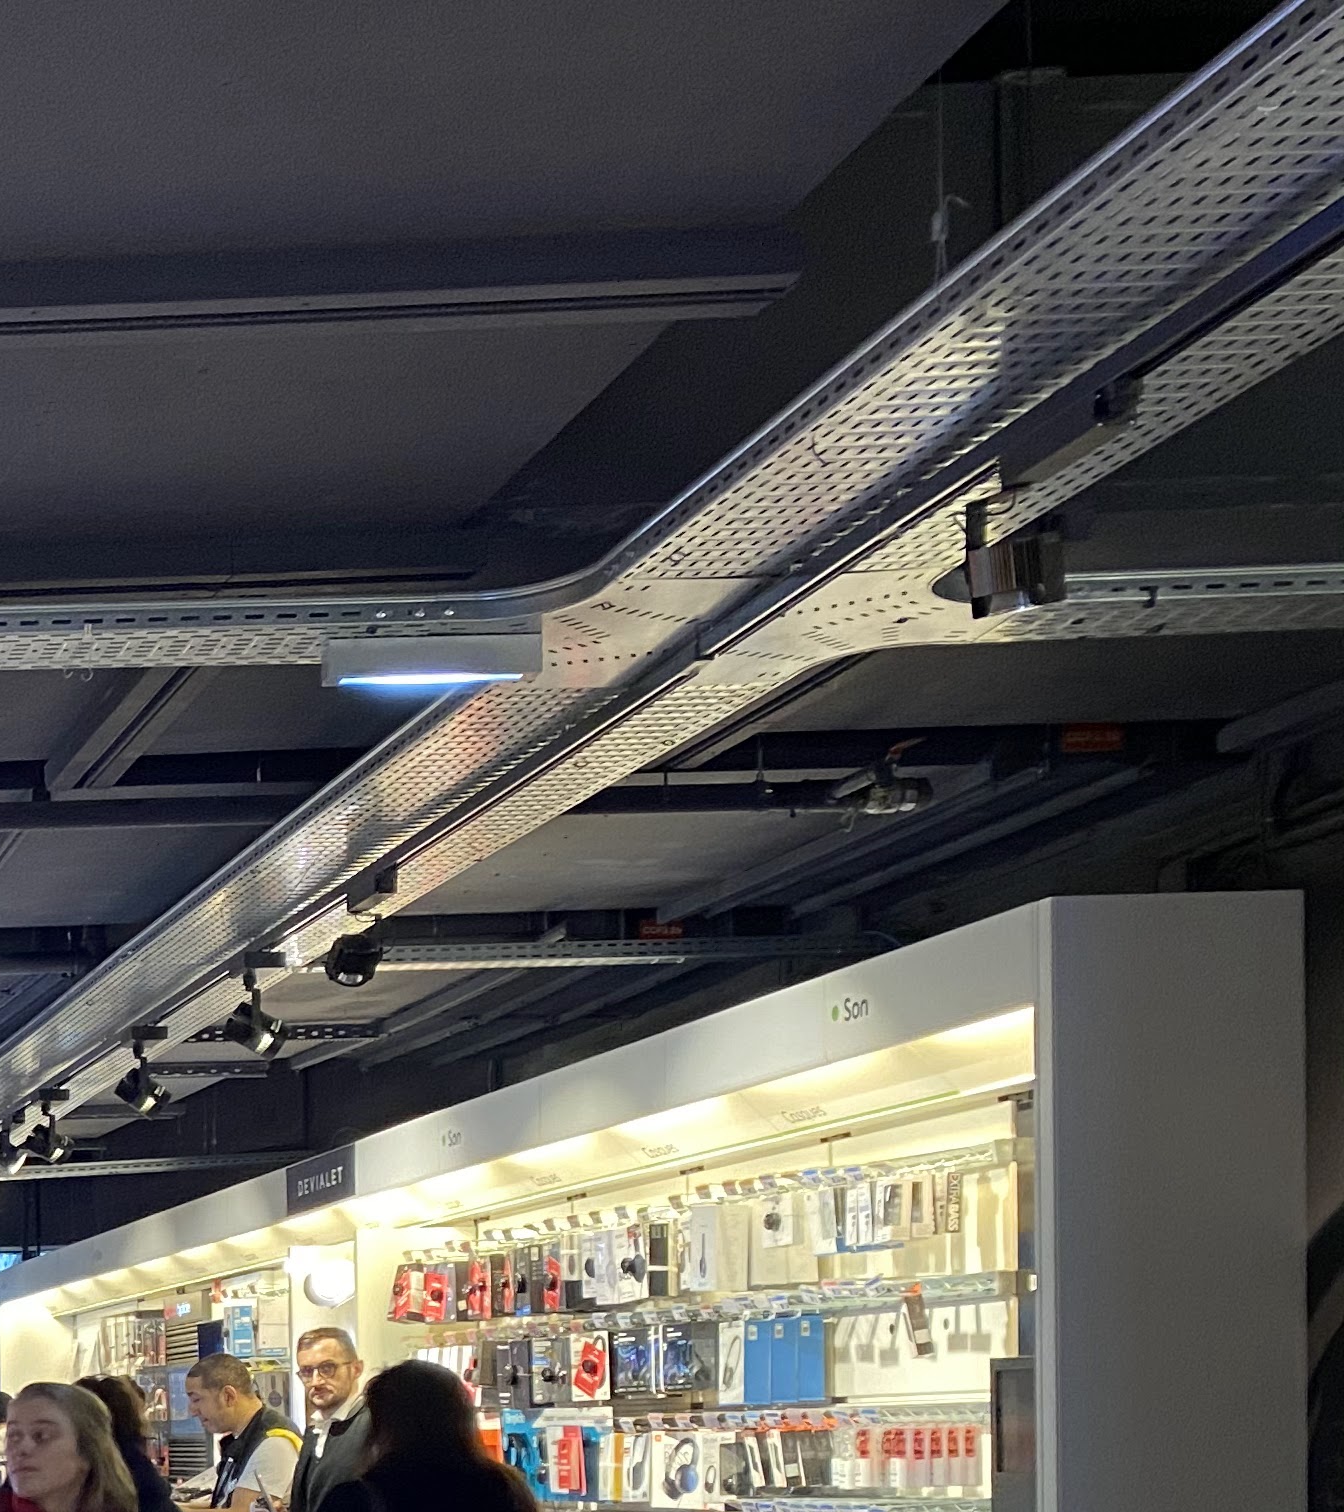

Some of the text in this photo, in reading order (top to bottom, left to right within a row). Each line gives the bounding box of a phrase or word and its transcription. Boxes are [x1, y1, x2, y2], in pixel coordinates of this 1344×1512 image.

[843, 996, 869, 1022] Son
[781, 1104, 827, 1126] Casques
[447, 1129, 462, 1147] Son
[641, 1142, 679, 1160] Casques
[296, 1166, 344, 1198] DEVIALET
